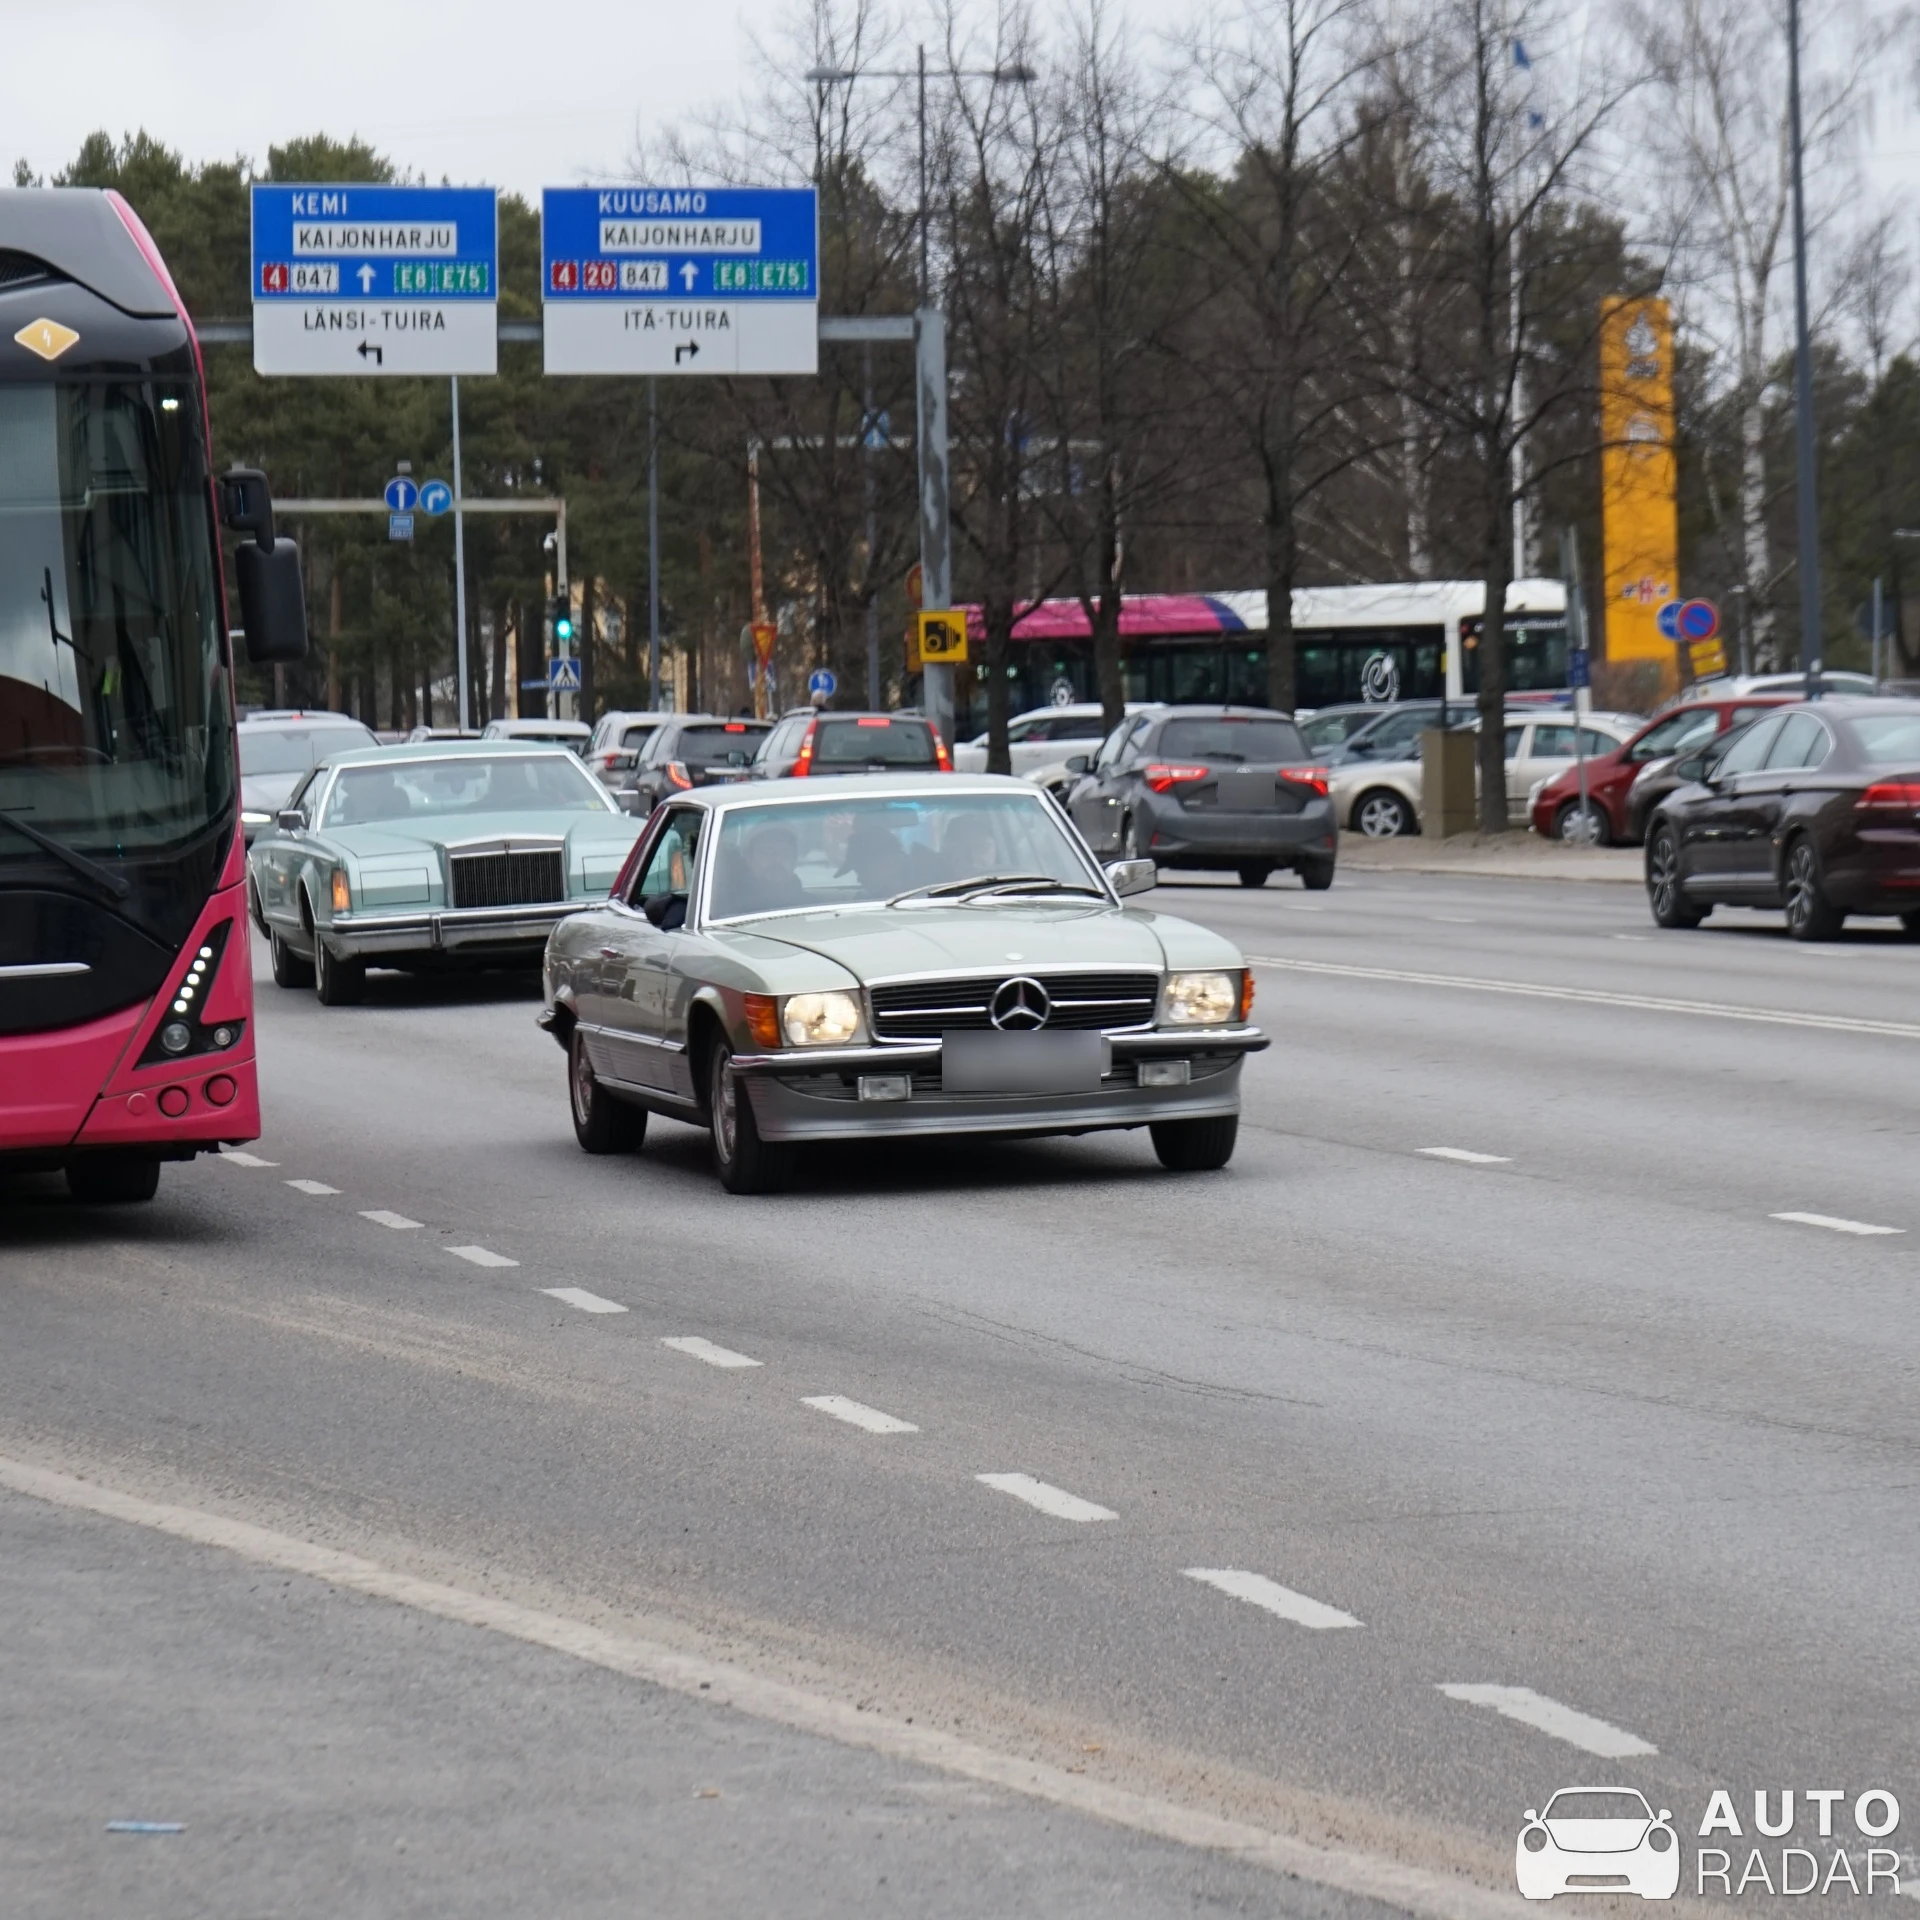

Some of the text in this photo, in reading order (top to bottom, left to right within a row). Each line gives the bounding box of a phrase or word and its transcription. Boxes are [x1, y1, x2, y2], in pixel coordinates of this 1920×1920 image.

[292, 192, 347, 215] KEMI
[599, 191, 707, 214] KUUSAMO
[299, 228, 451, 249] KAIJONHARJU
[603, 226, 755, 247] KAIJONHARJU
[269, 266, 480, 289] 4 847 E8 E75
[558, 263, 800, 287] 4 20 847 E8 E75
[304, 305, 446, 331] LÄNSI-TUIRA
[624, 305, 730, 331] ITÄ-TUIRA
